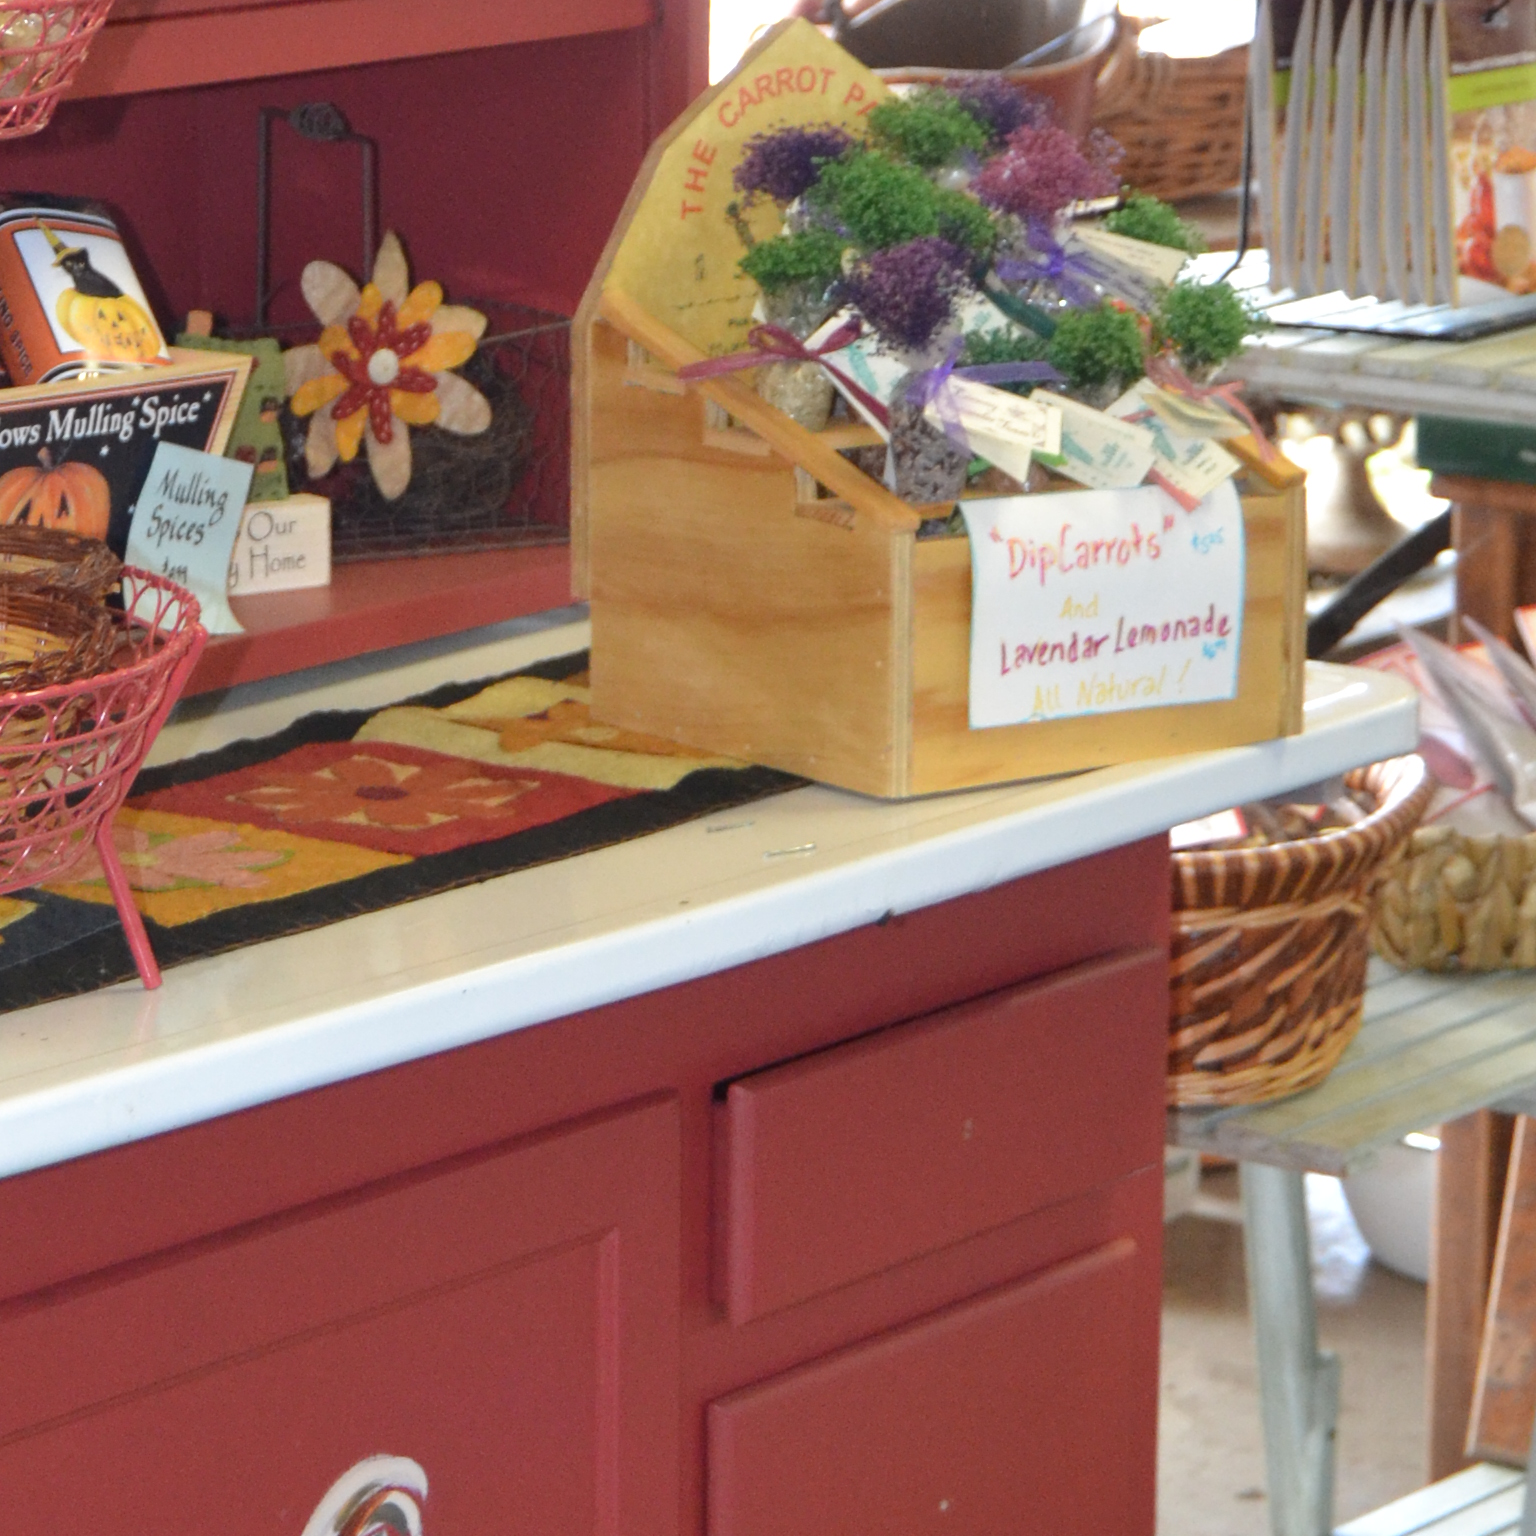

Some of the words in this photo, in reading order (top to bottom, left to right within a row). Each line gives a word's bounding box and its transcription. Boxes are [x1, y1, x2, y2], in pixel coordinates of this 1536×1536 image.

[680, 139, 718, 221] THE
[718, 65, 837, 128] CARROT
[45, 402, 136, 443] Mulling
[139, 393, 201, 438] Spice
[156, 467, 229, 527] Mulling
[147, 504, 206, 549] Spices
[247, 511, 297, 542] Our
[249, 545, 307, 580] Home
[1059, 593, 1099, 619] And
[1000, 630, 1110, 677] Lavendar
[1114, 602, 1232, 654] Lemonade
[1033, 682, 1062, 713] All
